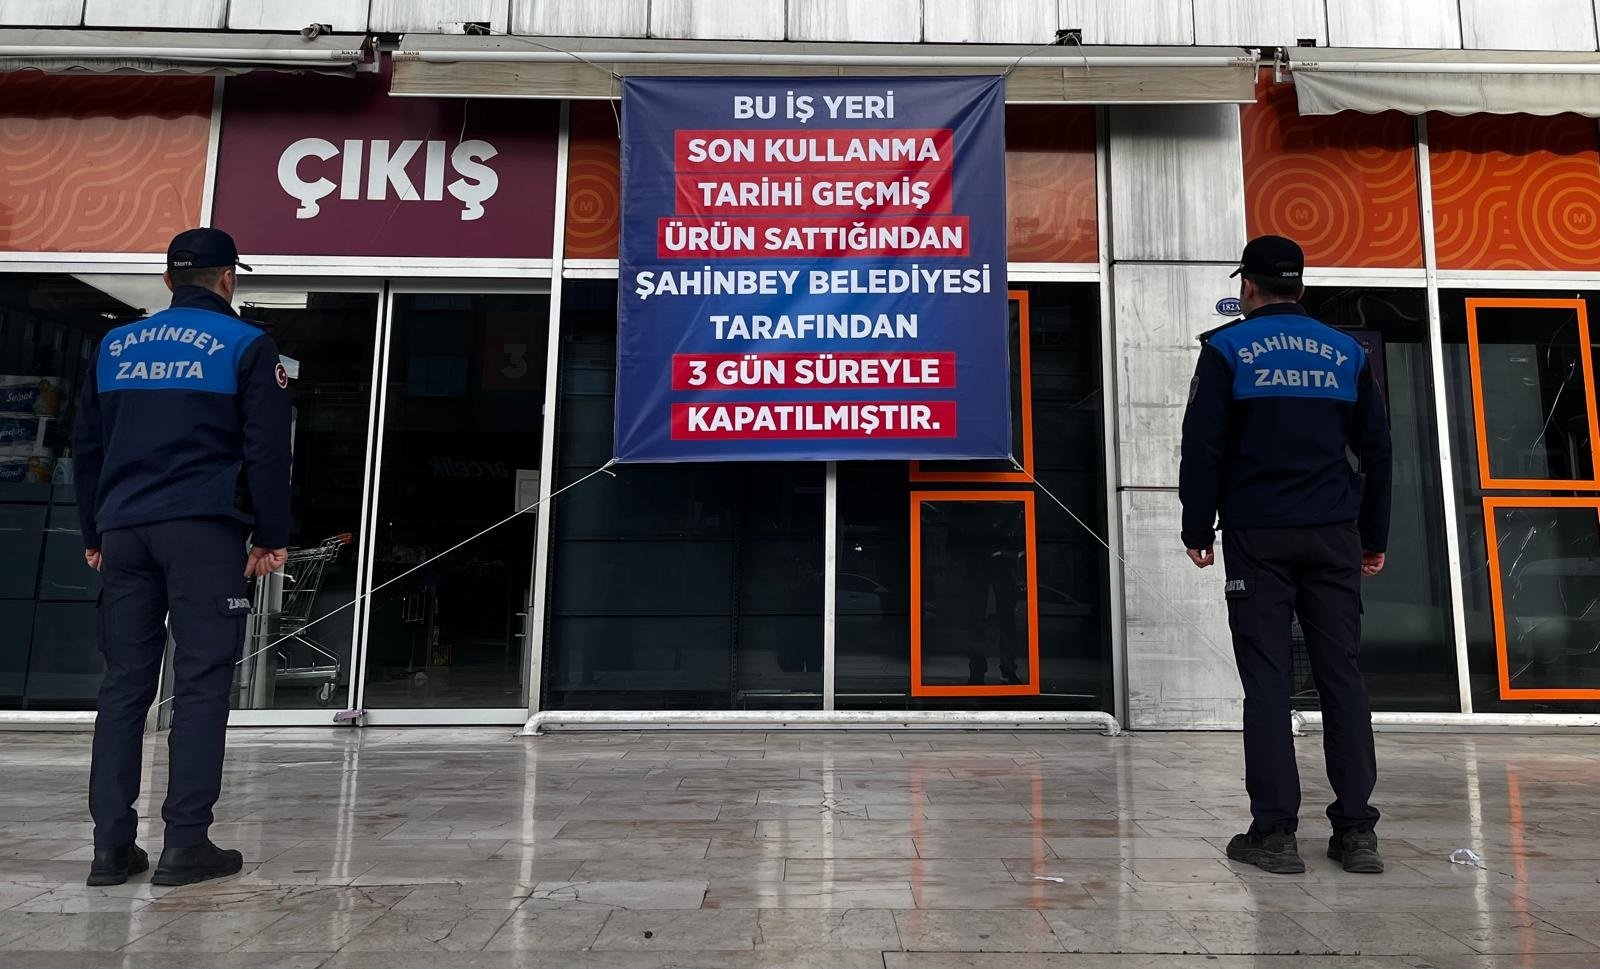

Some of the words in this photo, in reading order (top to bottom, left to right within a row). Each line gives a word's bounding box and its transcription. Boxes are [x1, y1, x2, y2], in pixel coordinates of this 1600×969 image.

[734, 95, 777, 119] BU
[786, 91, 815, 123] İŞ
[823, 90, 894, 119] YERİ
[687, 138, 755, 163] SON
[764, 137, 941, 162] KULLANMA
[277, 137, 499, 221] ÇIKIŞ
[698, 176, 802, 207] TARİHİ
[811, 176, 931, 211] GEÇMİŞ
[1295, 209, 1308, 219] M
[1573, 213, 1586, 223] M
[664, 221, 756, 251] ÜRÜN
[764, 221, 963, 251] SATTIĞINDAN
[635, 265, 801, 300] ŞAHİNBEY
[808, 263, 991, 295] BELEDİYESİ
[109, 324, 225, 357] ŞAHİNBEY
[709, 313, 918, 340] TARAFINDAN
[501, 343, 528, 378] 3
[1238, 332, 1348, 367] ŞAHİNBEY
[115, 360, 204, 380] ZABITA
[687, 360, 707, 386] 3
[716, 354, 786, 385] GÜN
[794, 353, 940, 385] SÜREYLE
[1254, 368, 1339, 389] ZABITA
[688, 404, 941, 435] KAPATILMIŞTIR.
